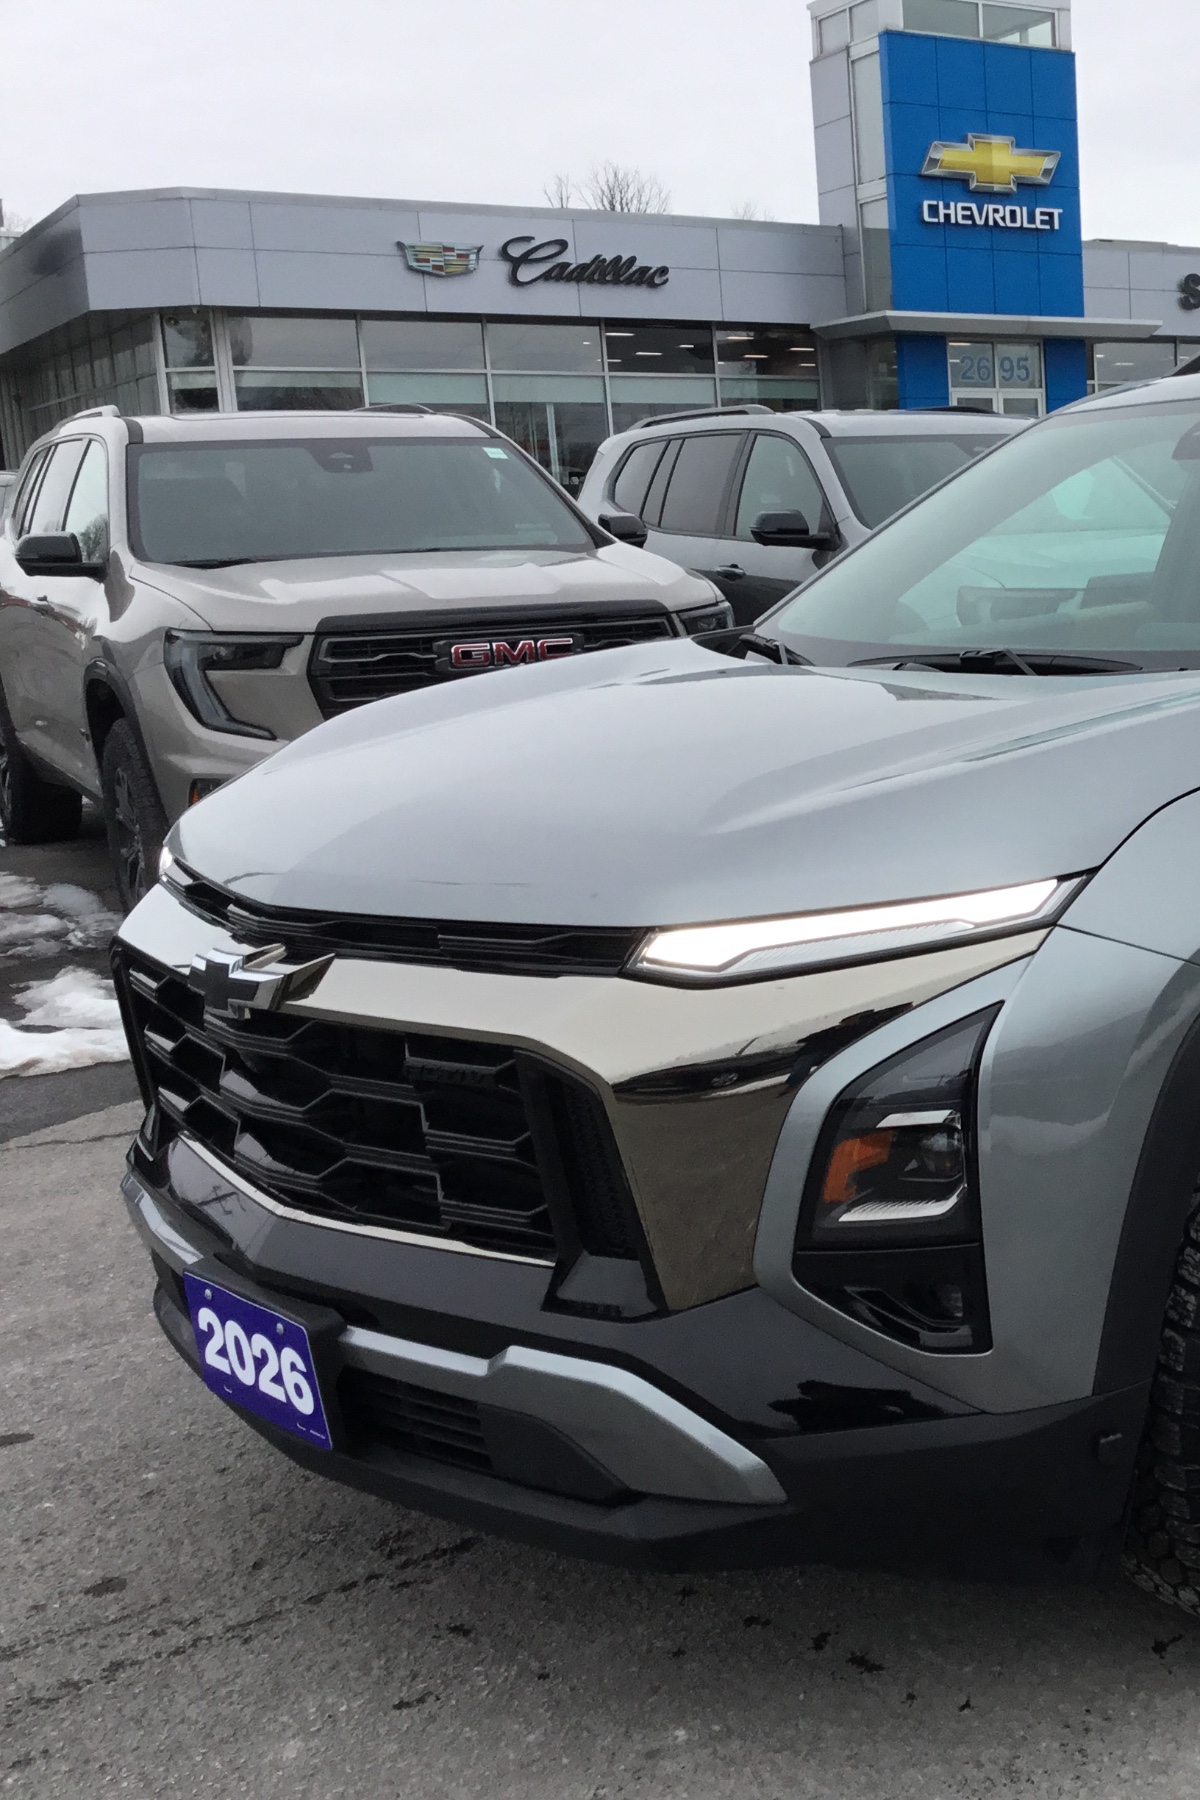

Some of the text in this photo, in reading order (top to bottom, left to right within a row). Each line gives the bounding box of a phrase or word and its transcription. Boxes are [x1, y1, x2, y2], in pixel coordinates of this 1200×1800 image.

[922, 199, 1063, 230] CHEVROLET
[499, 235, 670, 288] Cadillac
[451, 637, 573, 667] GMC
[197, 1307, 315, 1416] 2026
